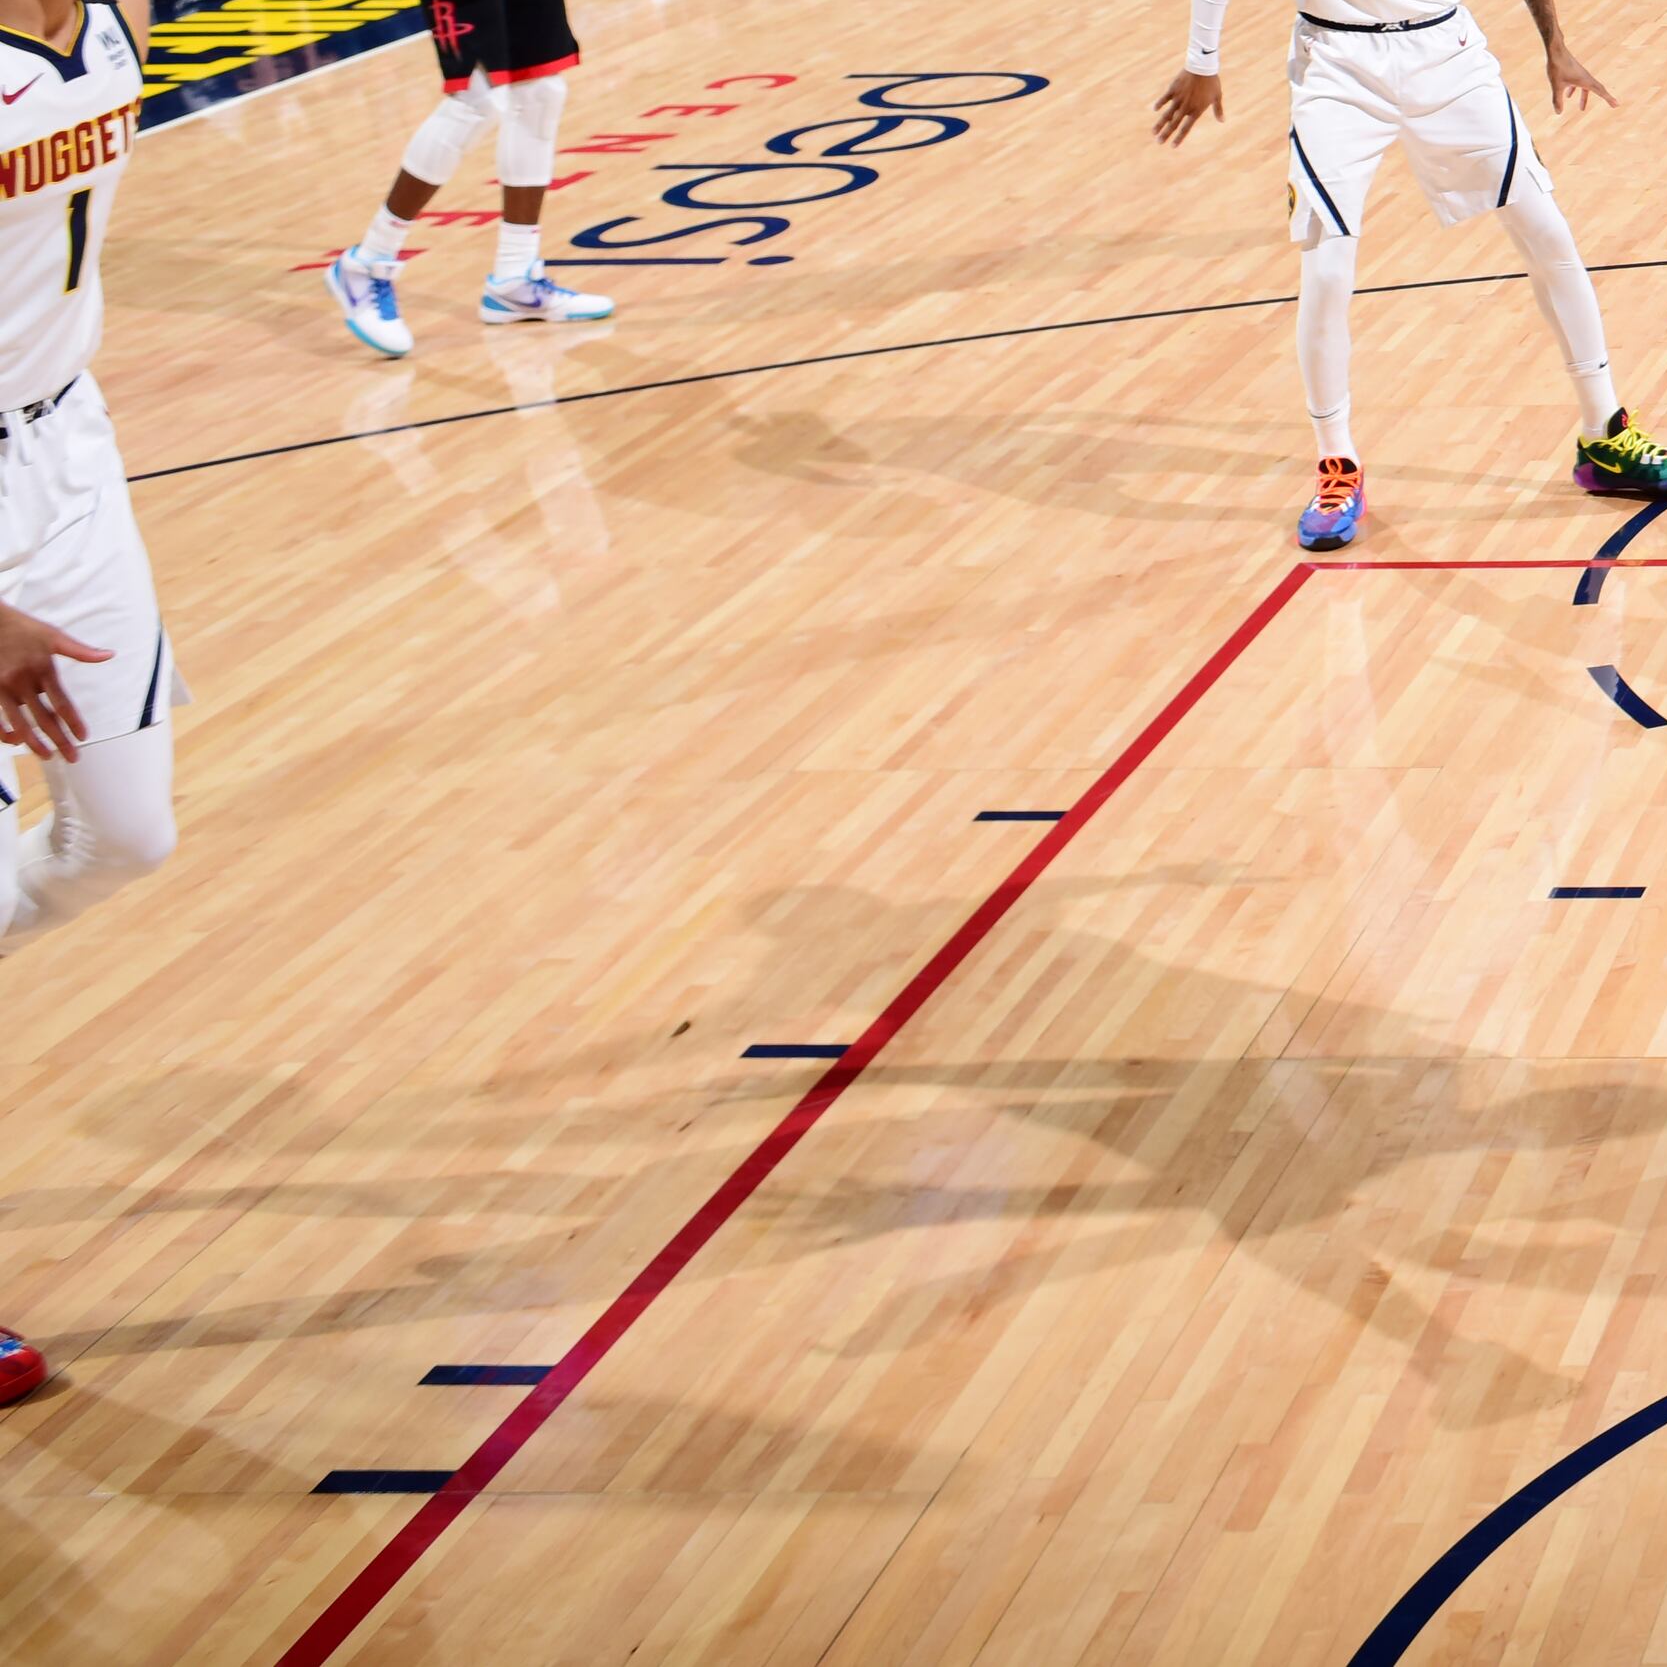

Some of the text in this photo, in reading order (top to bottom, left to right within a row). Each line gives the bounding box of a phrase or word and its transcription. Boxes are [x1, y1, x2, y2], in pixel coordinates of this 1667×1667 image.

[0, 96, 143, 201] NUGGET
[542, 71, 1051, 267] pepsi
[63, 186, 94, 296] 1
